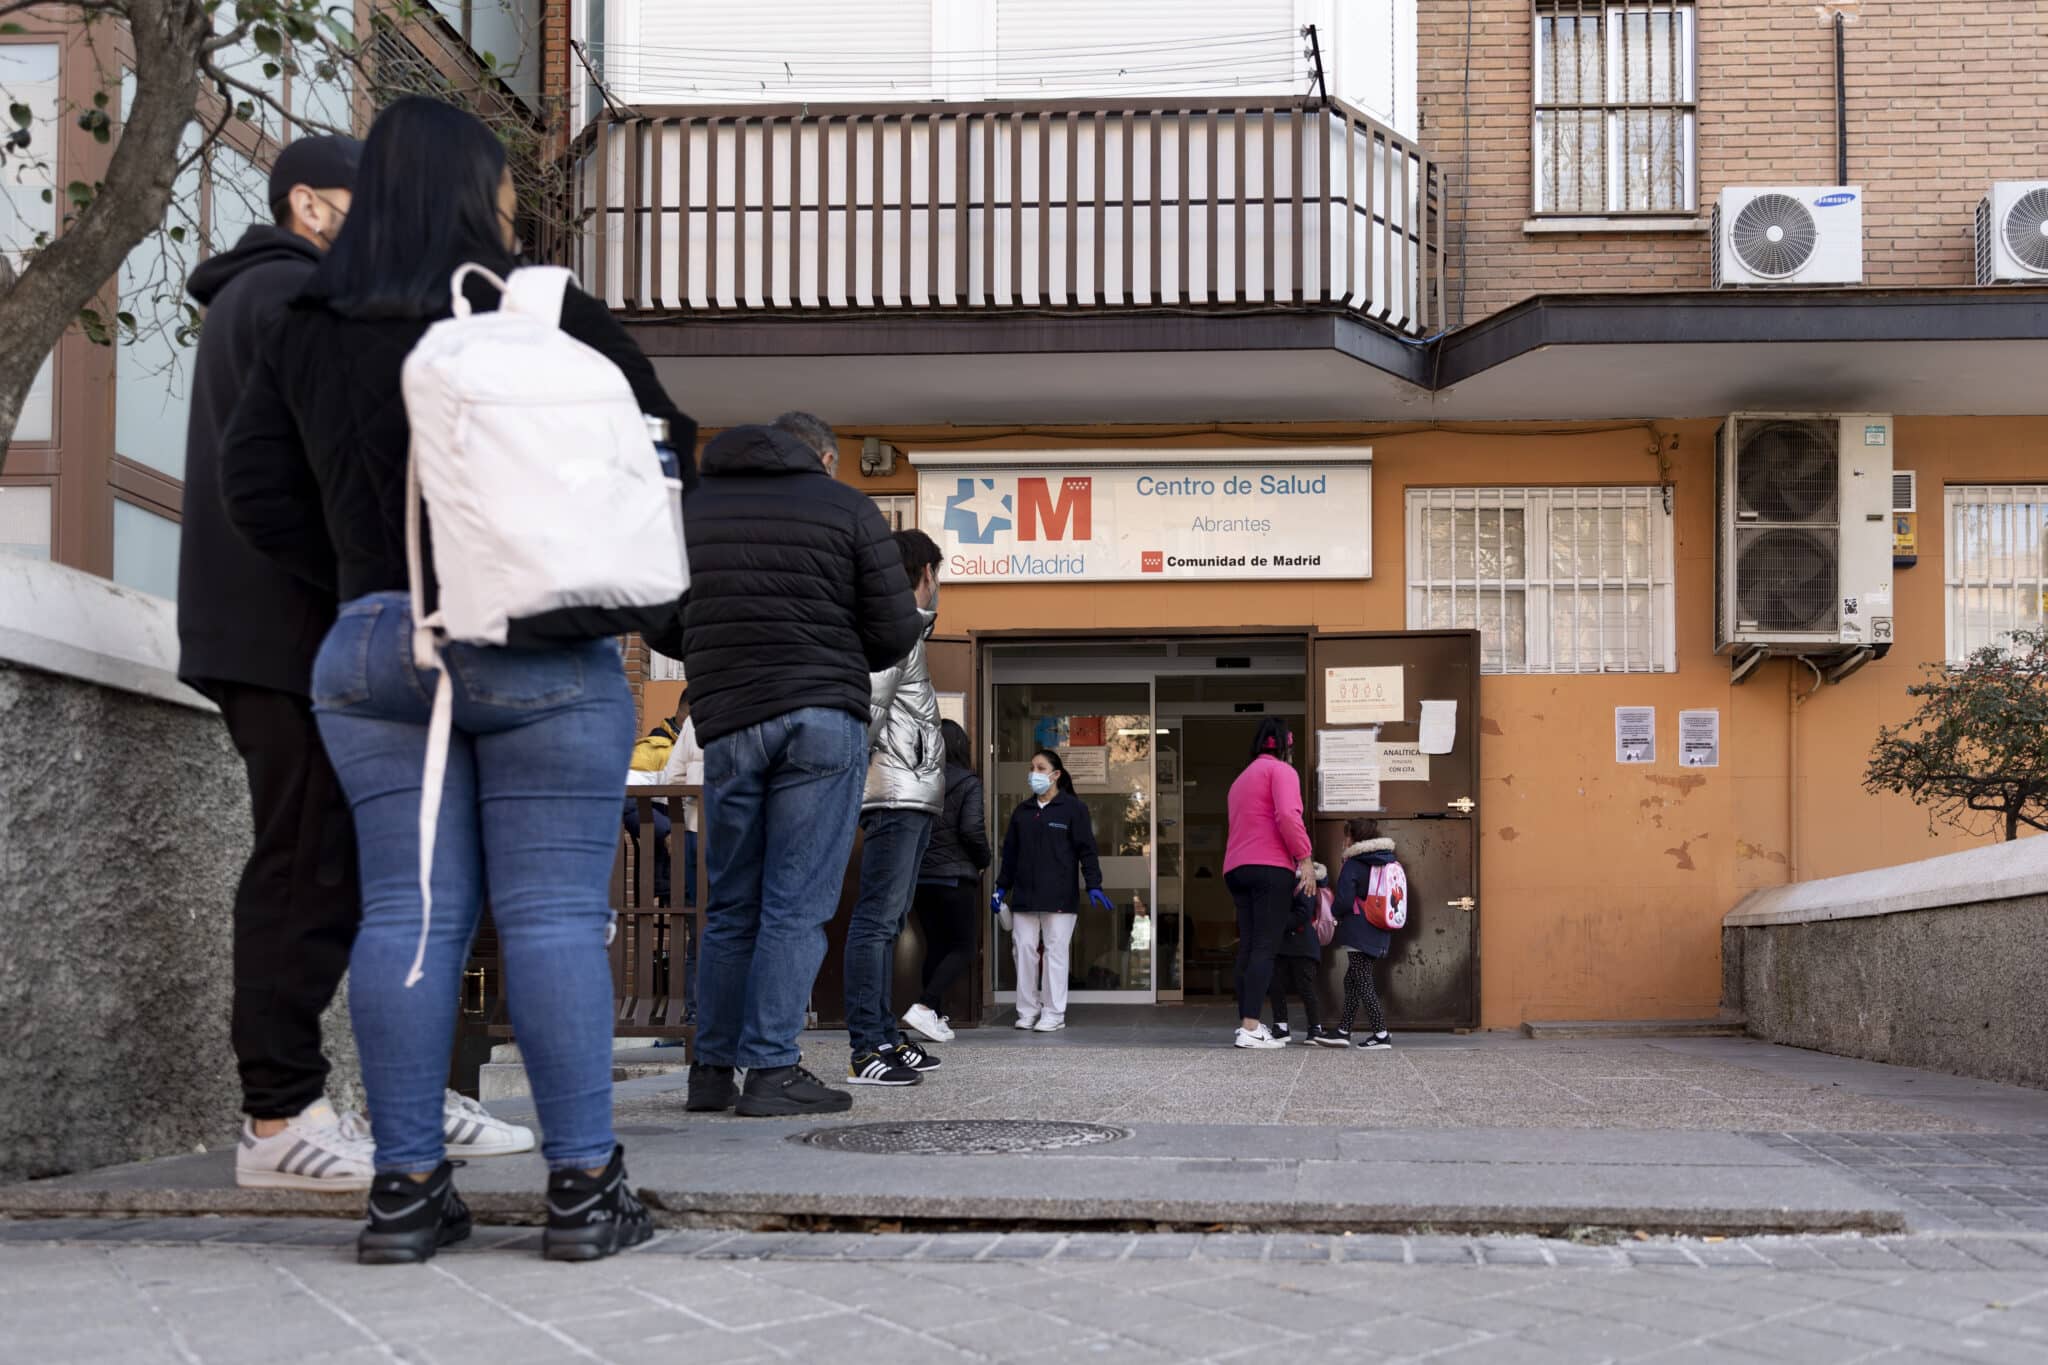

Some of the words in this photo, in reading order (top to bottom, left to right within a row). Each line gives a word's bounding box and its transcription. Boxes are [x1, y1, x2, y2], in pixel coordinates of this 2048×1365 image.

[1136, 475, 1215, 496] Centro
[1223, 475, 1253, 496] de
[1259, 474, 1327, 496] Salud
[1191, 516, 1272, 533] Abrantes
[949, 553, 1085, 576] SaludMadrid
[1166, 555, 1246, 567] Comunidad
[1250, 555, 1268, 567] de
[1273, 554, 1321, 567] Madrid
